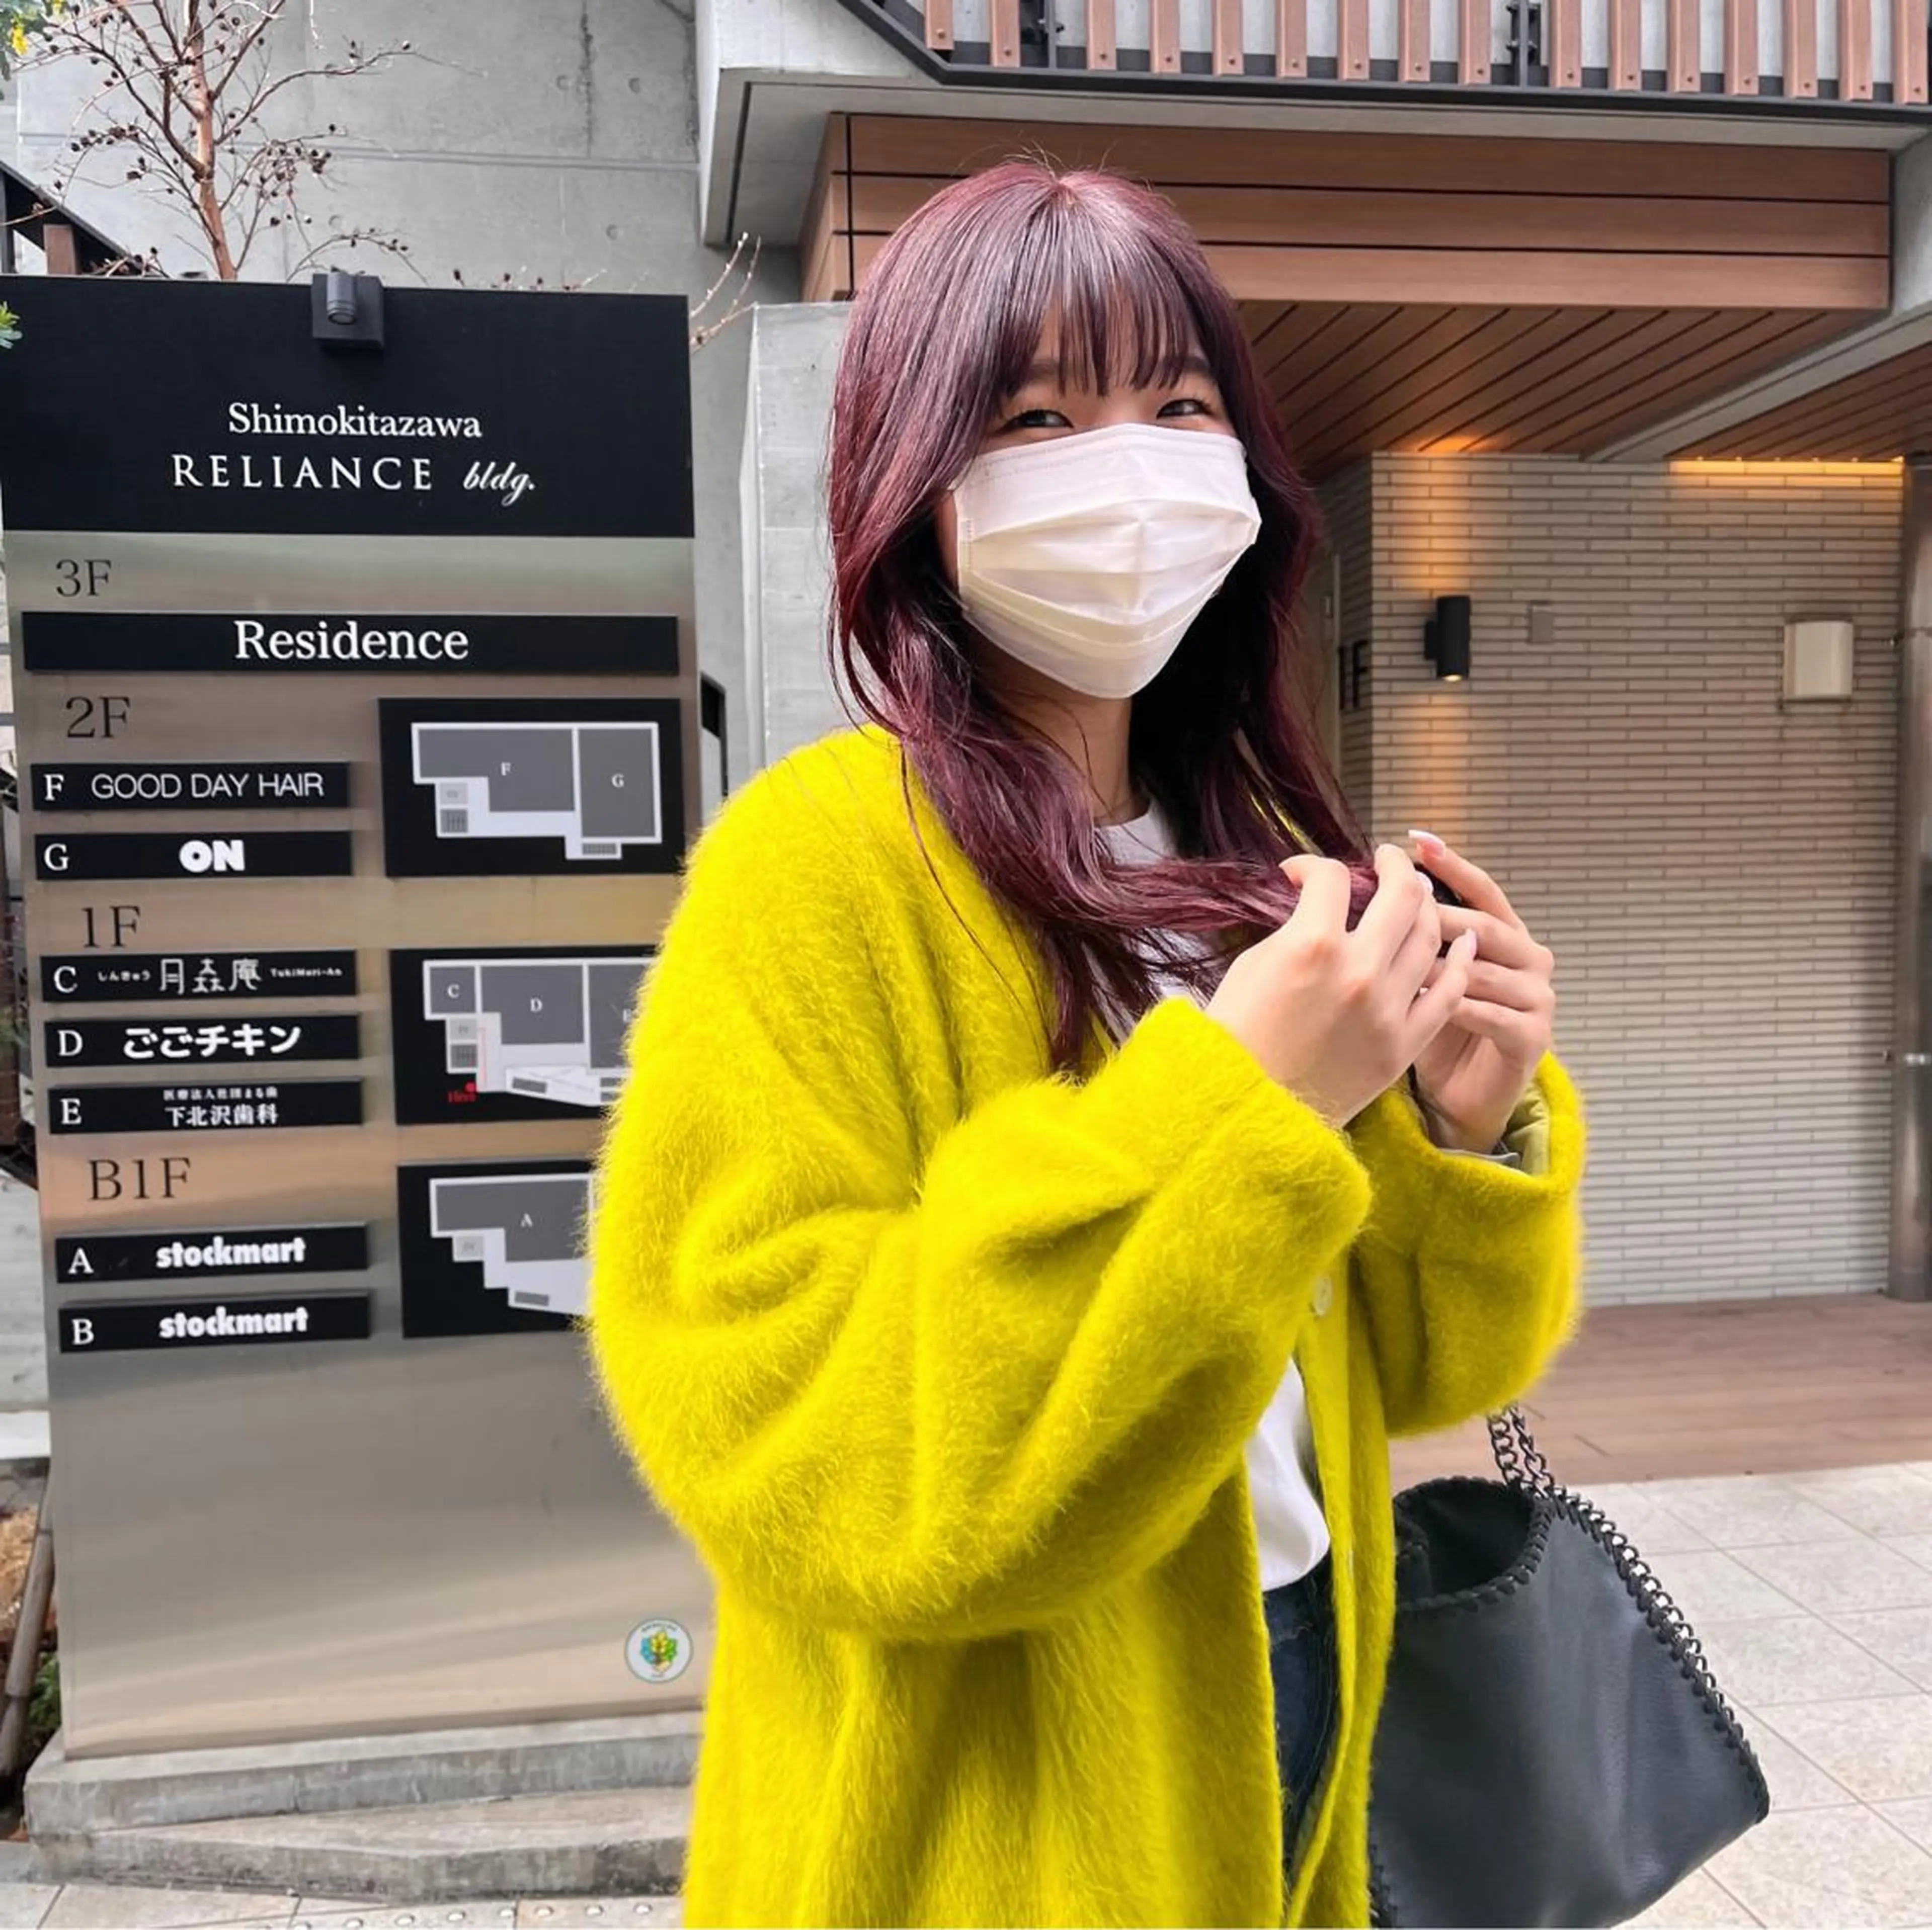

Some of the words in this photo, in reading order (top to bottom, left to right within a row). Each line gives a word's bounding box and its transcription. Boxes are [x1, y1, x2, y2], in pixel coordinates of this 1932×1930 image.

[228, 402, 483, 438] Shimokitazawa
[171, 454, 432, 490] RELIANCE
[462, 461, 535, 506] bldg.
[55, 559, 112, 596] 3F
[233, 620, 469, 660] Residence
[65, 696, 130, 738] 2F
[44, 773, 65, 801] F
[91, 773, 183, 799] GOOD
[191, 773, 250, 798] DAY
[258, 772, 325, 797] HAIR
[501, 762, 512, 776] F
[611, 773, 625, 788] G
[43, 843, 69, 871] G
[179, 839, 246, 873] ON
[82, 905, 140, 948] 1F
[53, 965, 77, 993] C
[447, 984, 459, 998] C
[530, 998, 543, 1012] D
[57, 1029, 83, 1057] D
[123, 1024, 301, 1058] ごごチキン
[60, 1098, 82, 1125] E
[165, 1104, 278, 1127] 下北沢歯科
[89, 1157, 191, 1201] B1F
[520, 1213, 533, 1227] A
[68, 1247, 94, 1275] A
[155, 1236, 306, 1268] stockmart
[71, 1318, 95, 1345] B
[158, 1305, 308, 1338] stockmart
